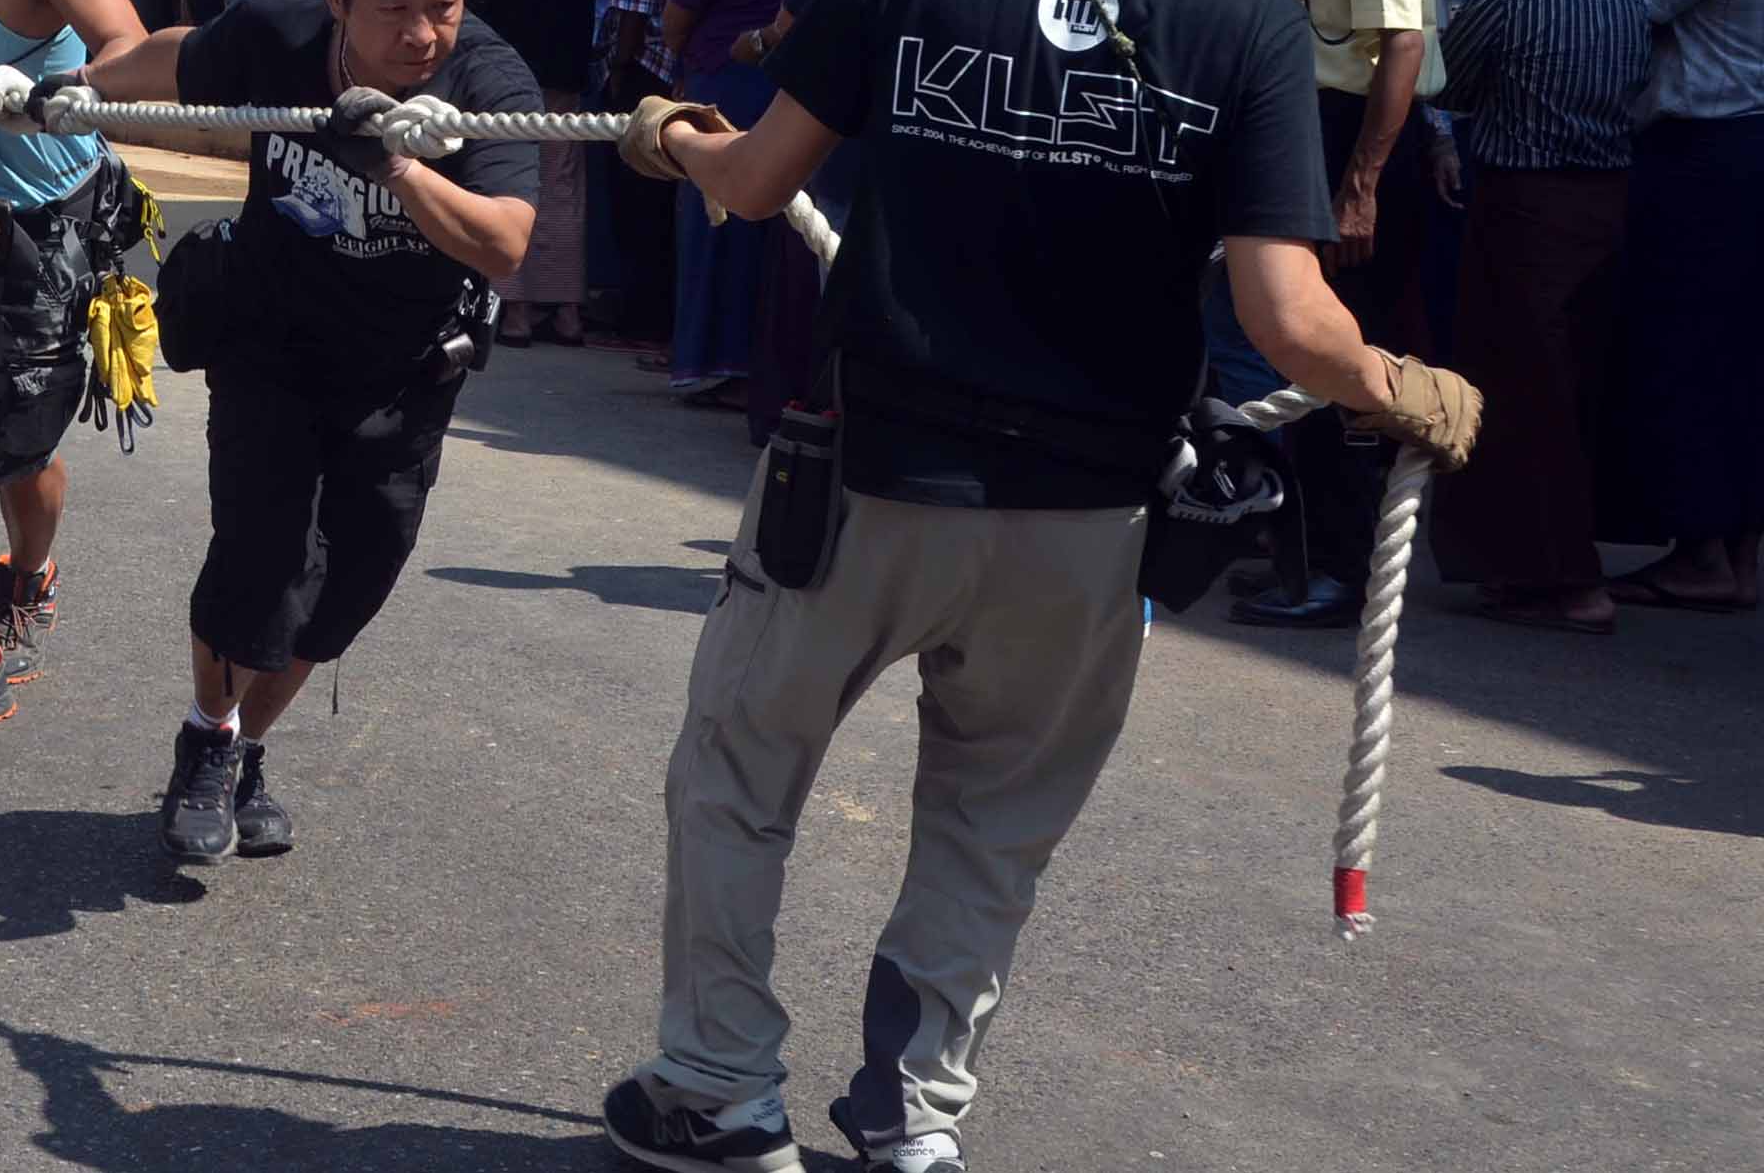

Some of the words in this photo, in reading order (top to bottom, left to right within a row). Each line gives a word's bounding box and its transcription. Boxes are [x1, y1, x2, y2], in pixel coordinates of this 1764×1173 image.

[892, 35, 1220, 165] KLST
[891, 124, 921, 136] SINCE
[948, 134, 967, 147] THE
[1032, 150, 1047, 161] OF
